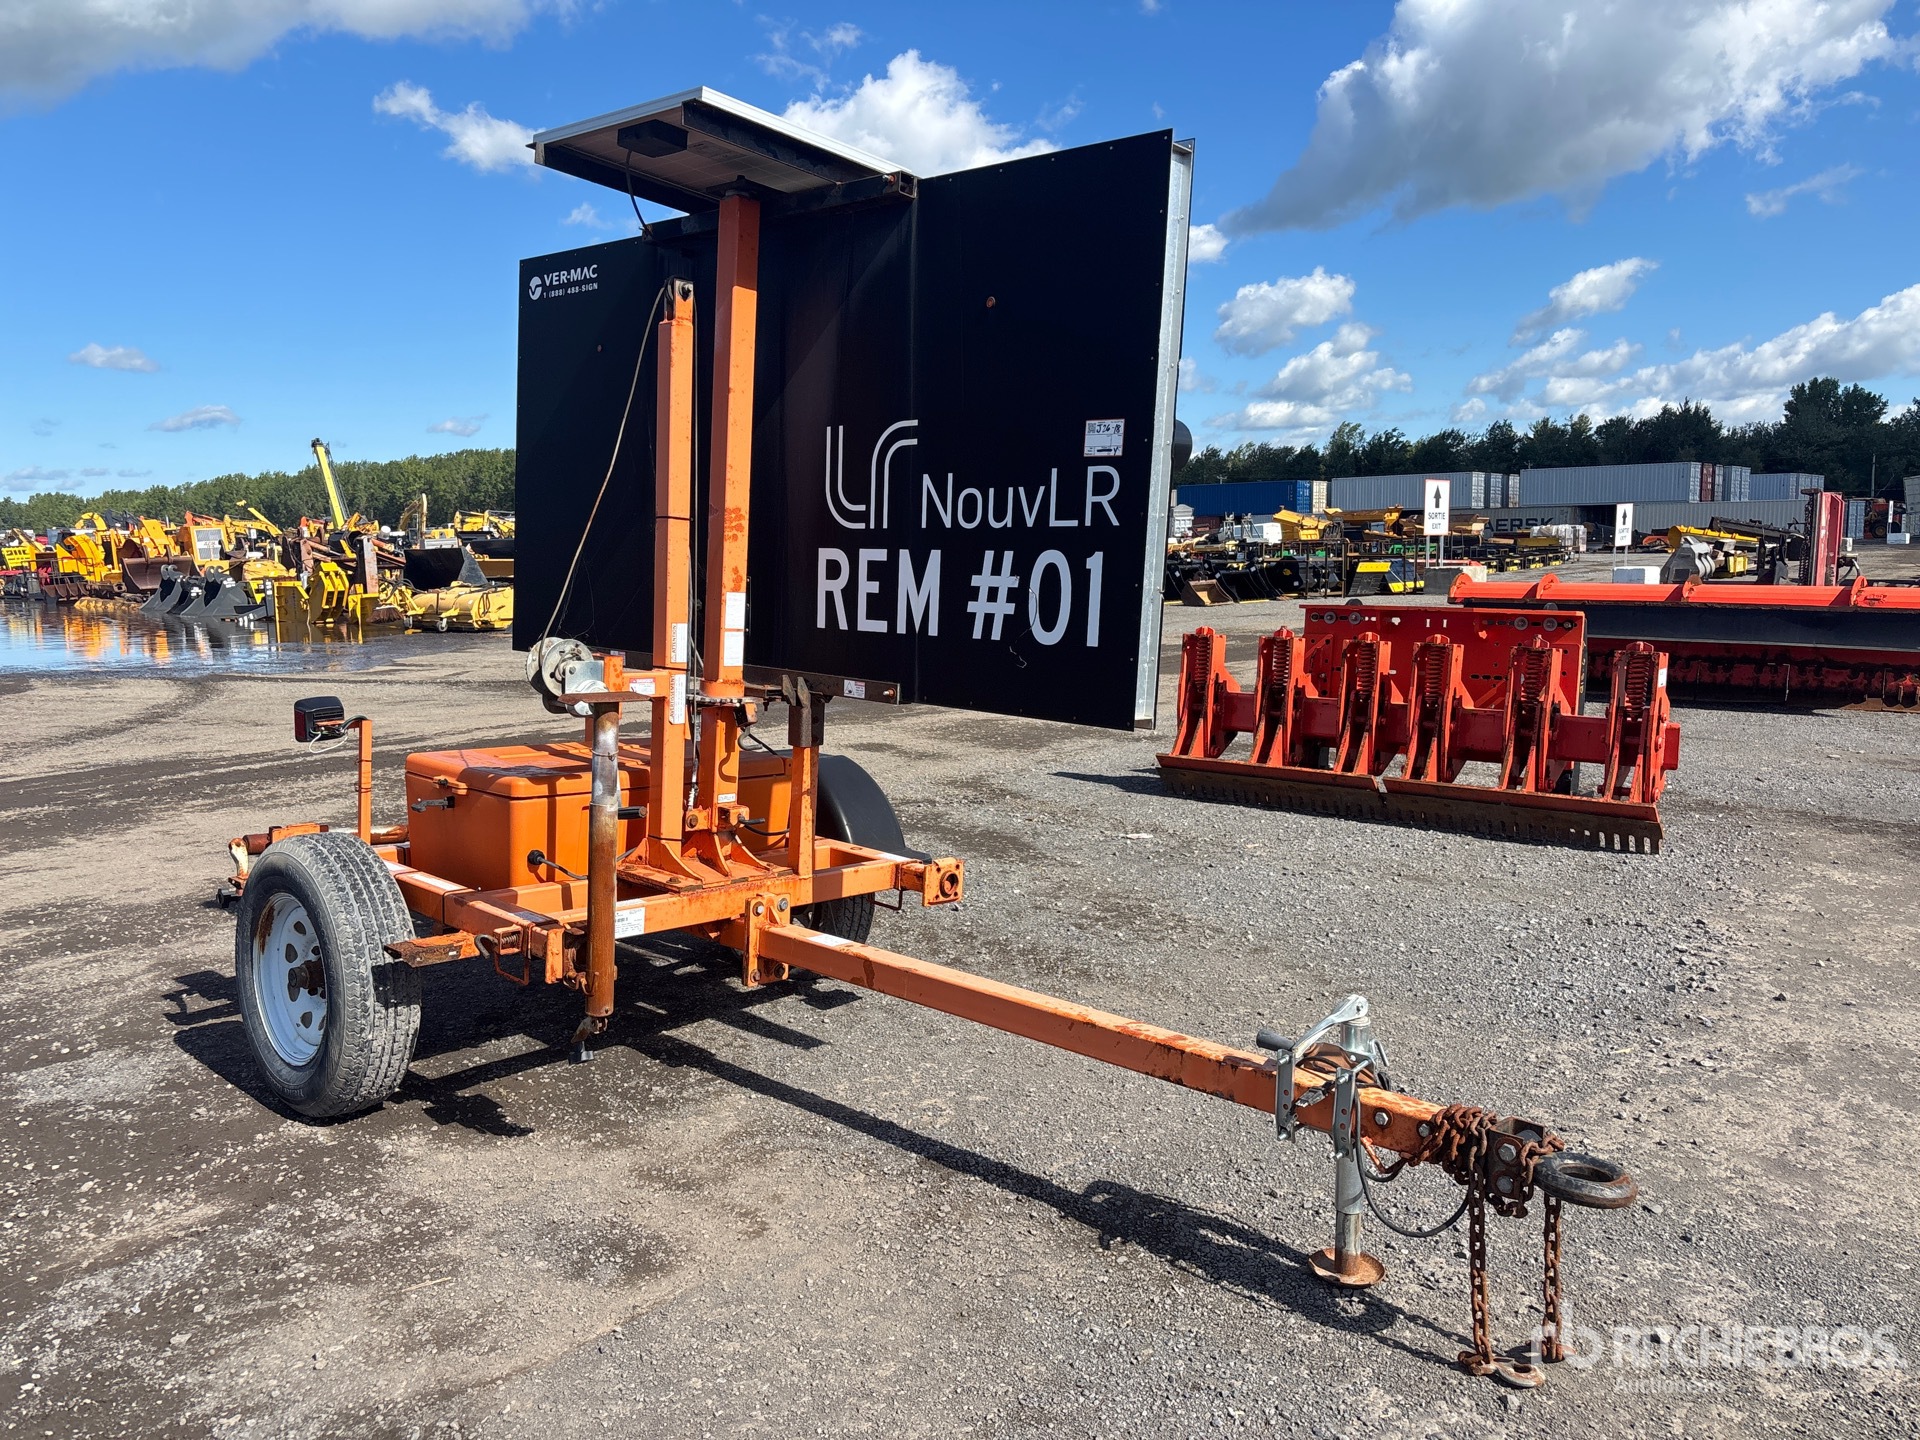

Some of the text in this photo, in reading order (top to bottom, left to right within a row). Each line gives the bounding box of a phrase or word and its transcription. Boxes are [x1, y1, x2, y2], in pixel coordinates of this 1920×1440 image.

[543, 264, 598, 287] VER-MAC
[549, 288, 566, 298] (888)
[567, 282, 598, 294] 488-SIGN
[921, 465, 1121, 529] NouvLR
[1428, 511, 1446, 520] SORTIE
[1431, 522, 1442, 530] EXIT
[1484, 517, 1554, 532] AERSK
[816, 548, 1104, 648] REM #01
